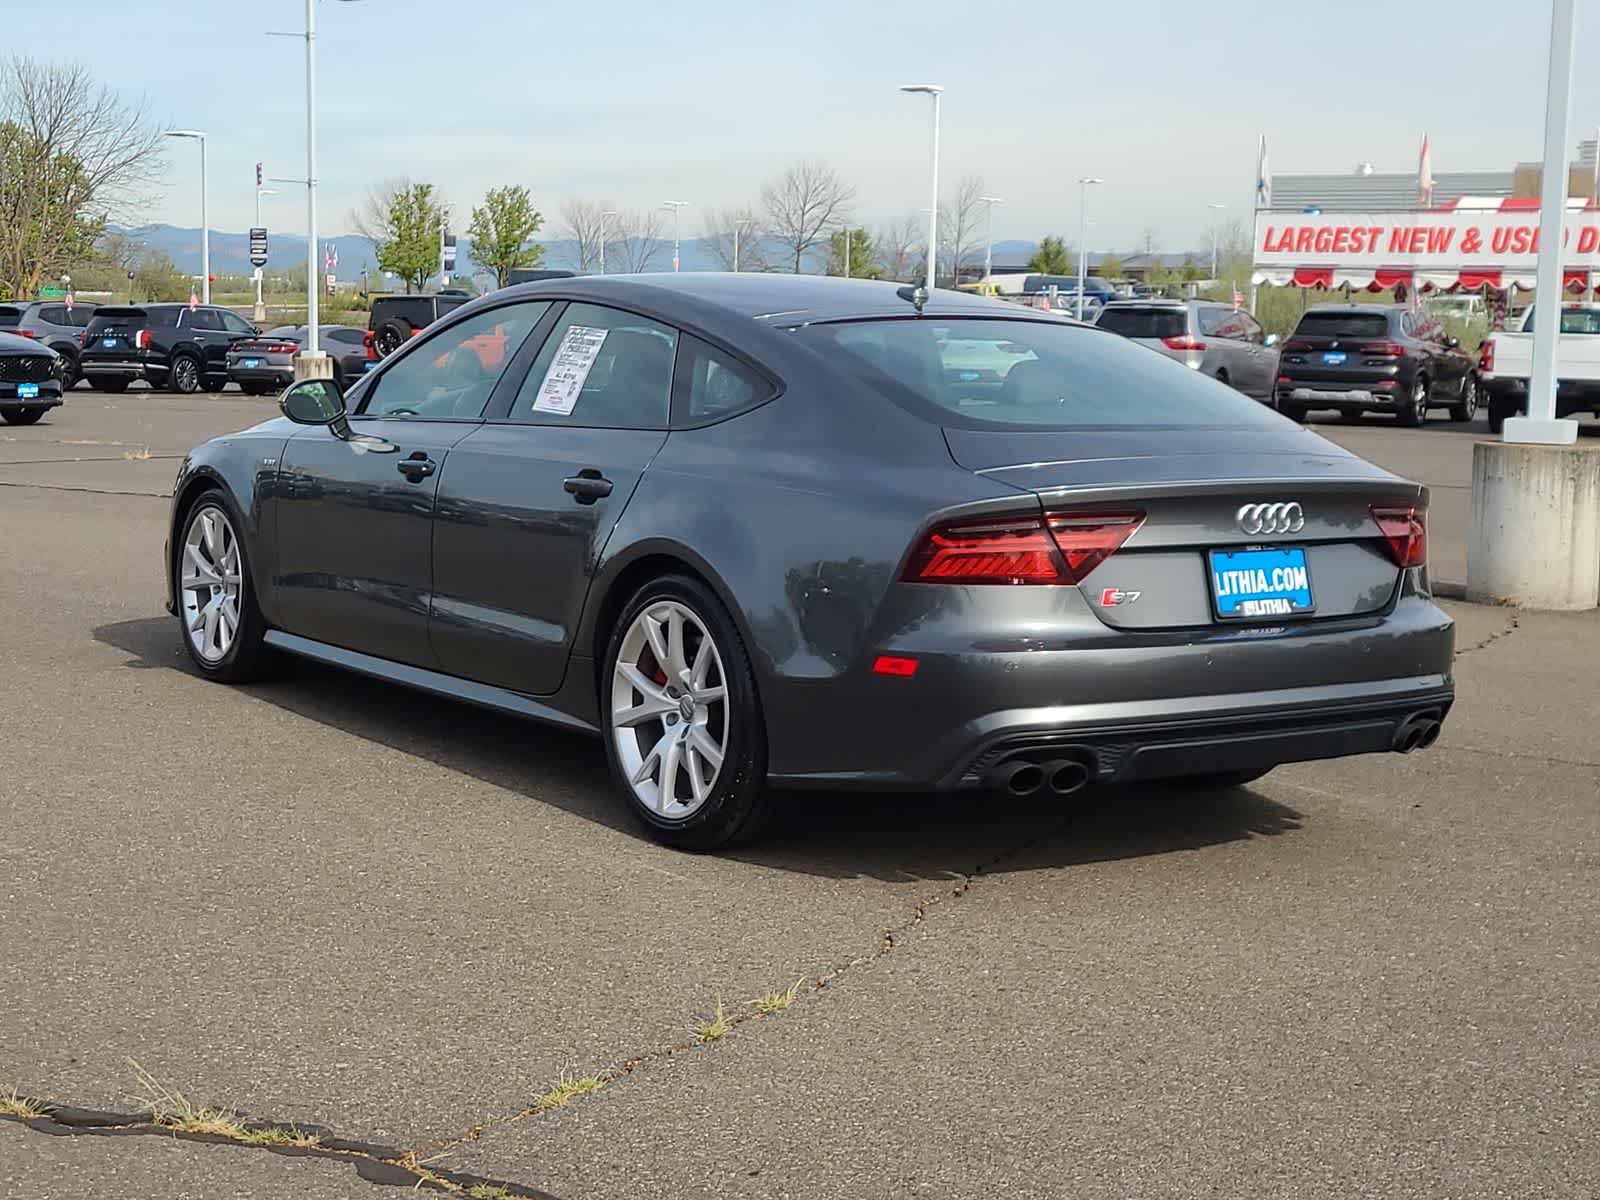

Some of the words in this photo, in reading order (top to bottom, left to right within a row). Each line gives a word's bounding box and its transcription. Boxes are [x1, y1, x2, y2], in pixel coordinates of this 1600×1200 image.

[1263, 226, 1384, 253] LARGEST
[1388, 226, 1457, 254] NEW
[1460, 226, 1483, 254] &
[1491, 226, 1570, 254] US
[1576, 226, 1600, 254] D
[1215, 566, 1308, 596] LITHIA.COM
[1107, 590, 1141, 605] S7
[1255, 598, 1292, 615] LITHIA
